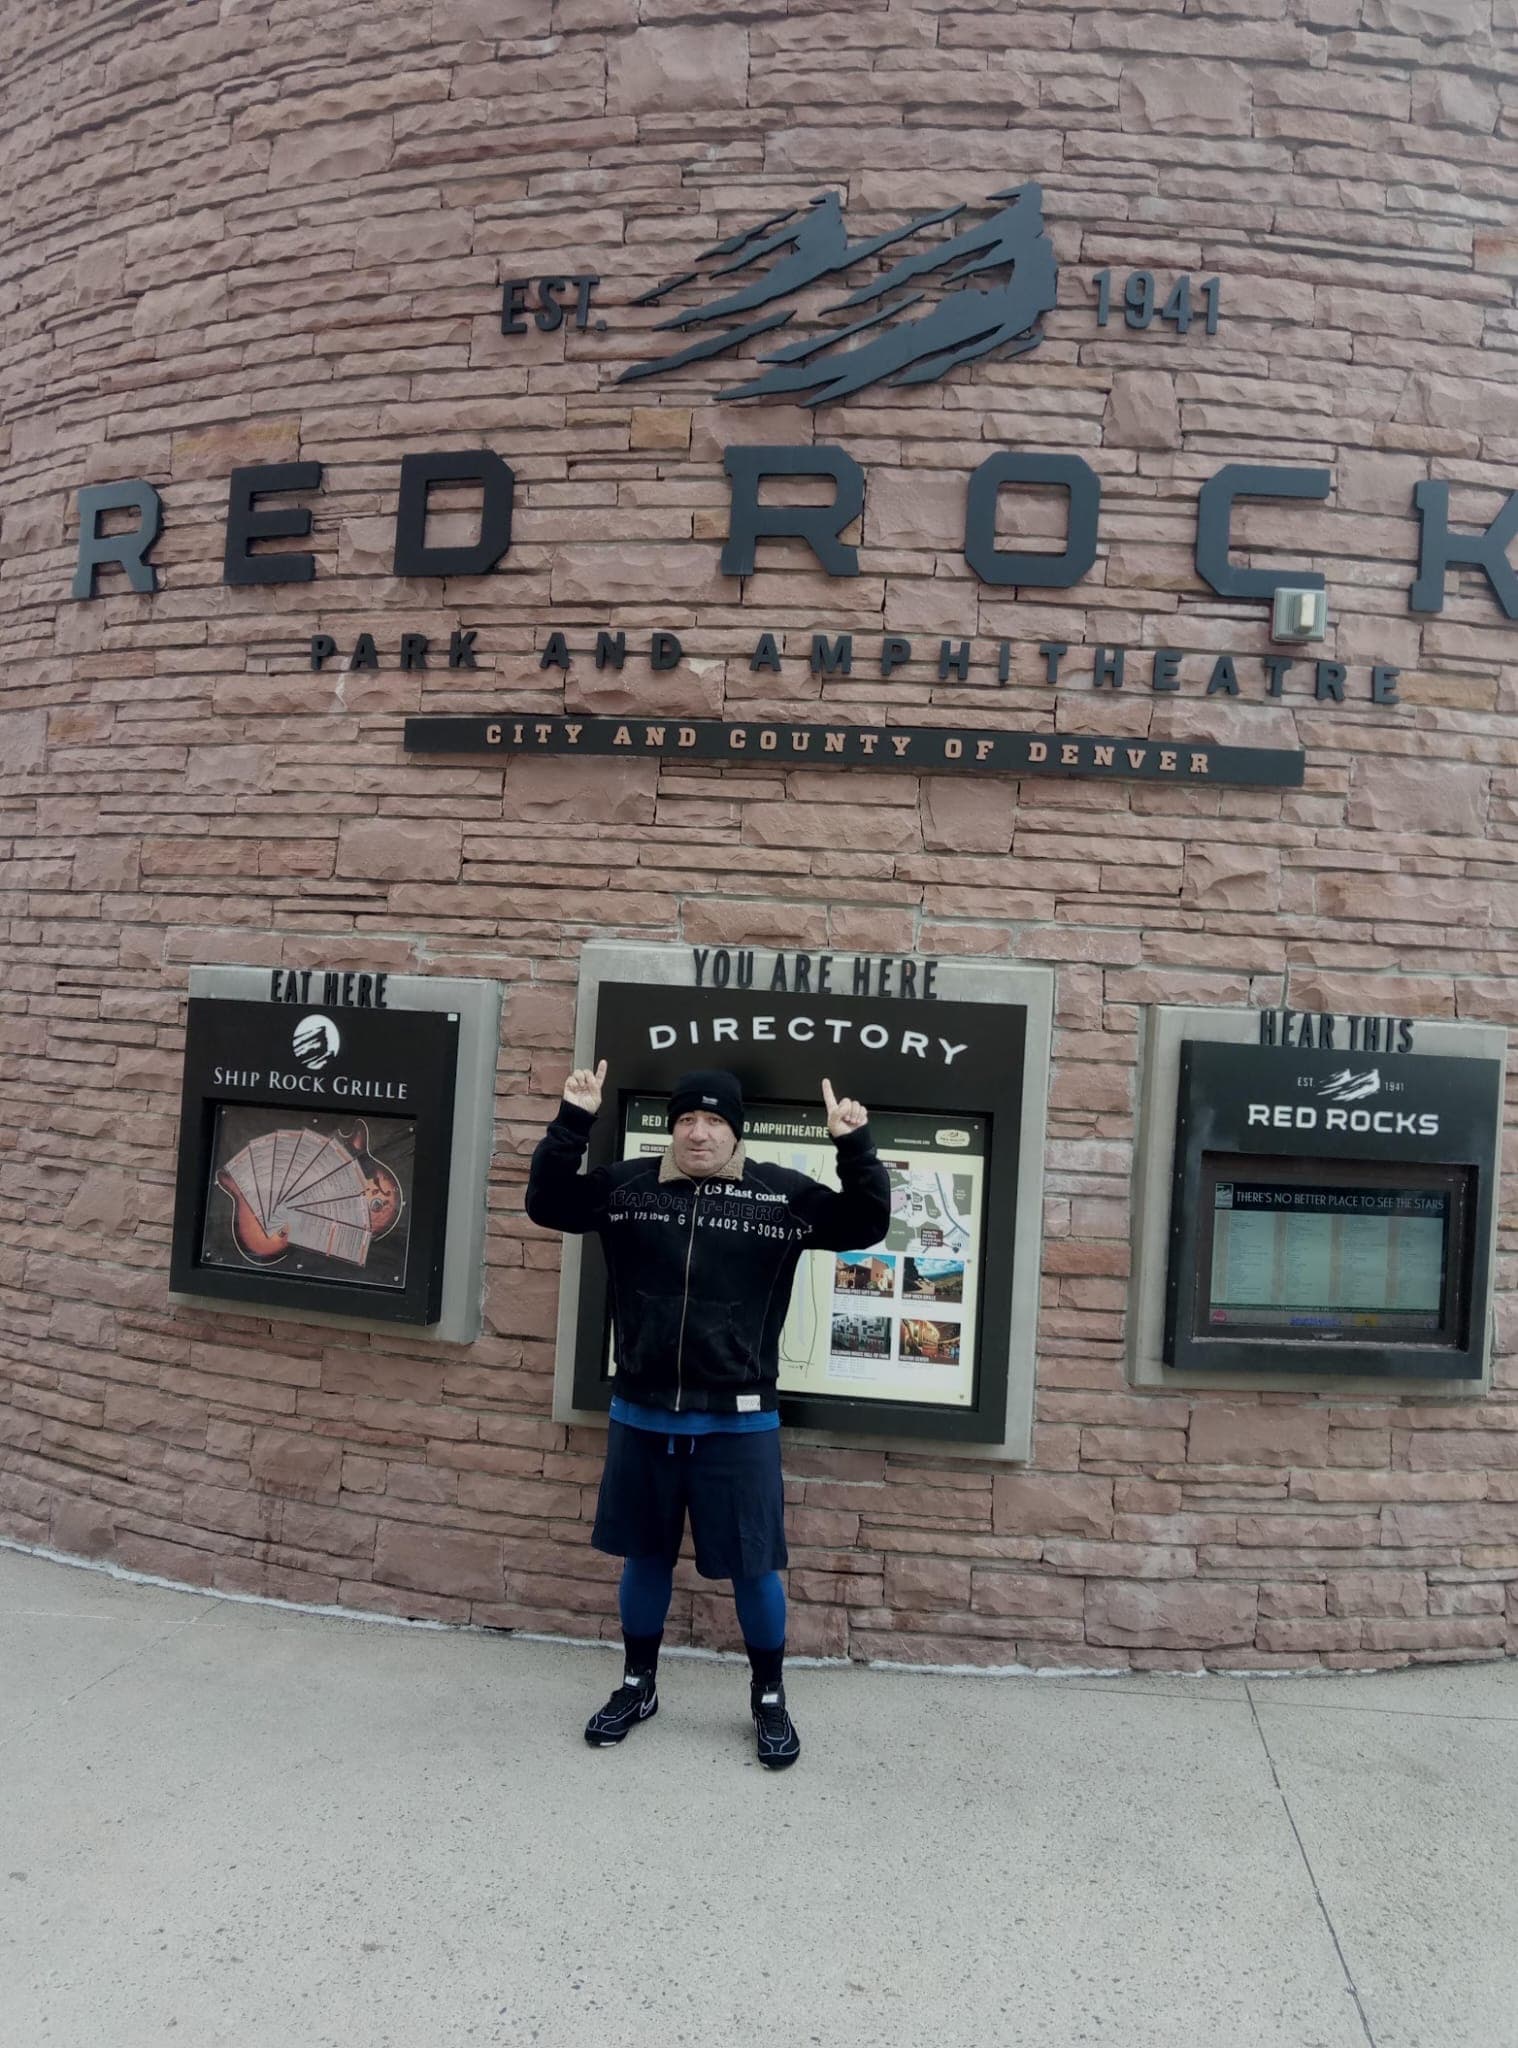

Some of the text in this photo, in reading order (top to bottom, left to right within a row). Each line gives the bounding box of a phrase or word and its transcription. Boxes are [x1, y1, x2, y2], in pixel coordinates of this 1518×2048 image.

[501, 268, 1220, 335] EST. 1941
[70, 449, 516, 600] RED
[309, 631, 1402, 705] PARK AND AMPHITHEATRE
[486, 724, 1211, 774] CITY AND COUNTY OF DENVER
[270, 969, 388, 1008] EAT HERE
[693, 949, 938, 1000] YOU ARE HERE
[649, 1016, 968, 1066] DIRECTORY
[1260, 1010, 1414, 1053] HEAR THIS
[213, 1066, 408, 1100] SHIP ROCK GRILLE
[1385, 1081, 1404, 1092] 1941
[641, 1114, 662, 1127] RED
[752, 1119, 830, 1138] AMPHITHEATRE
[1247, 1103, 1440, 1136] RED ROCKS
[704, 1184, 722, 1196] US
[724, 1184, 753, 1199] East
[1236, 1191, 1445, 1211] THERE'S NO BETTER PLACE TO SEE THE STARS
[709, 1217, 738, 1231] 4402
